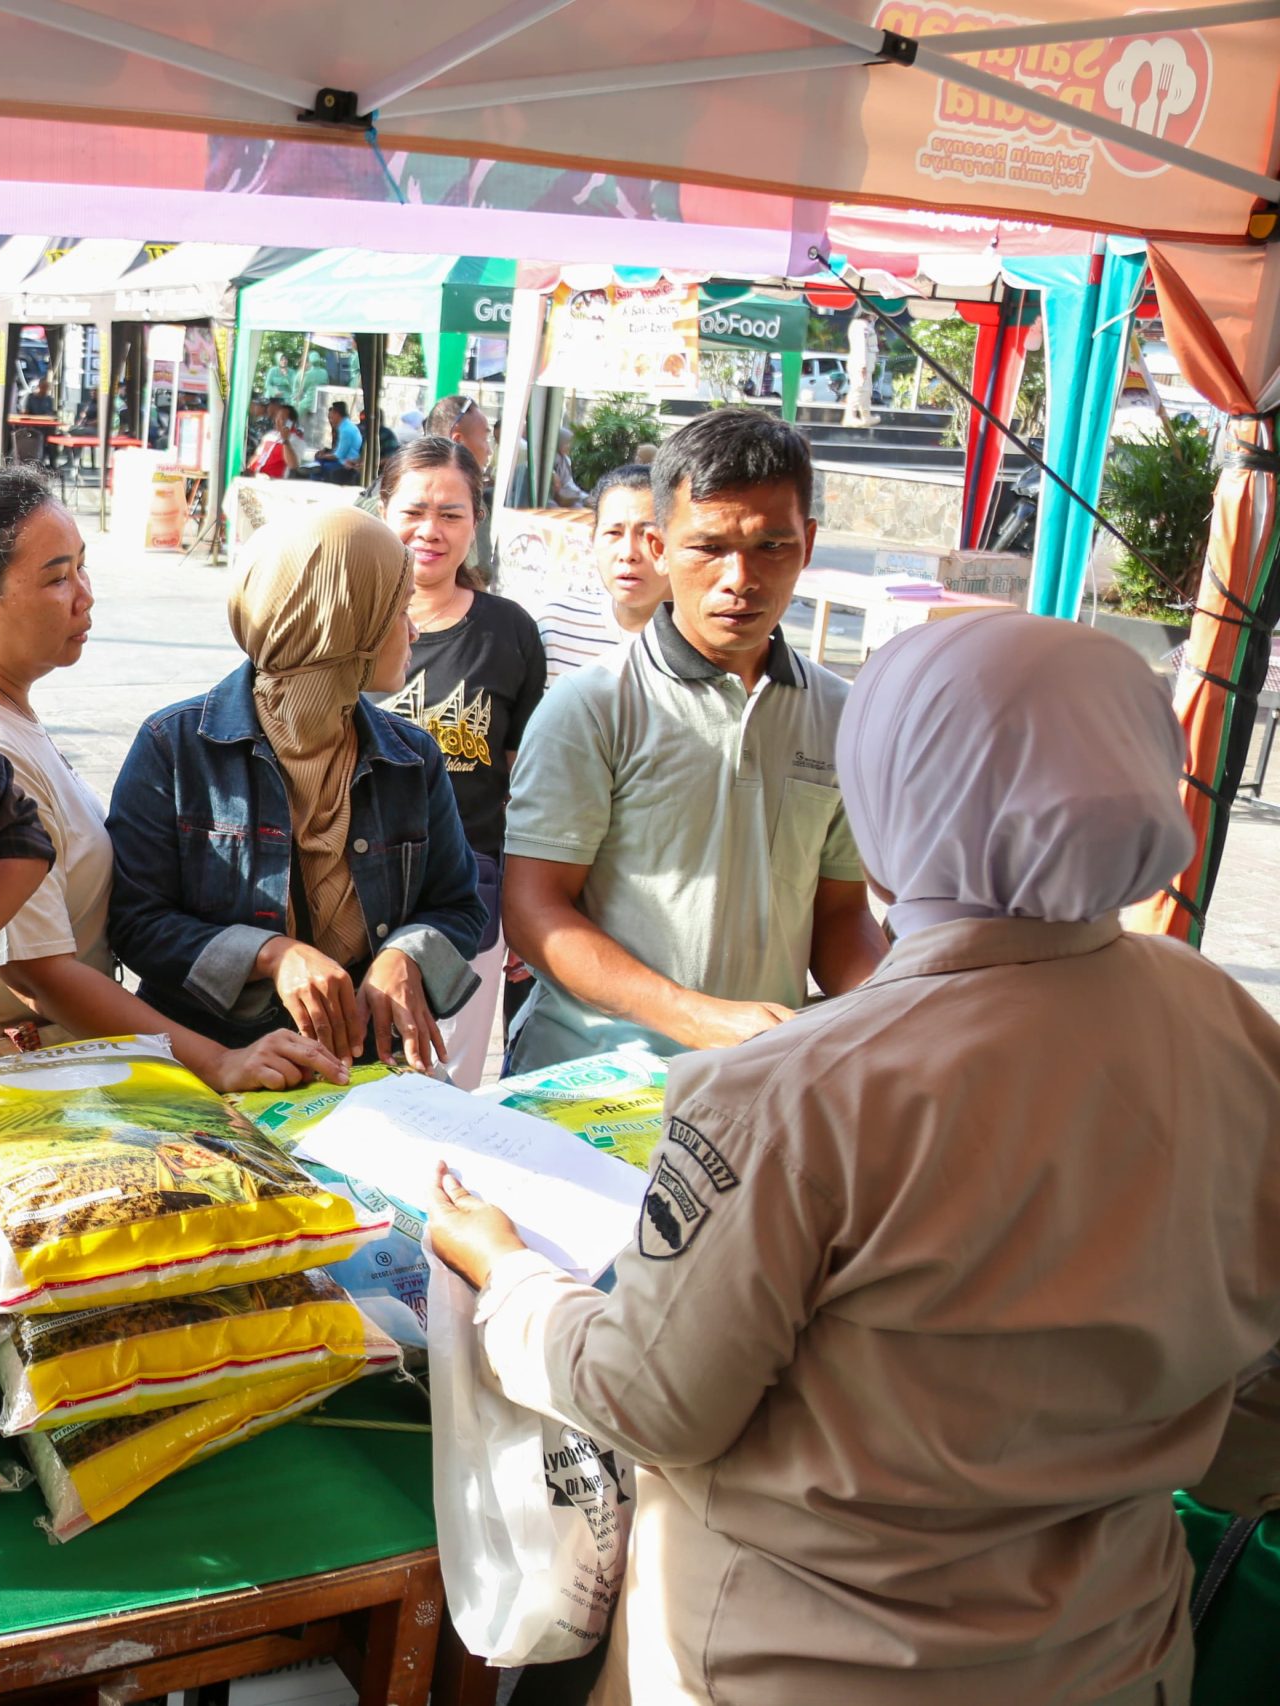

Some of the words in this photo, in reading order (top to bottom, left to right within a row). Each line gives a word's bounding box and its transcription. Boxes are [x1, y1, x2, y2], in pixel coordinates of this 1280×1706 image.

[592, 1120, 645, 1135] MUTU
[671, 1122, 703, 1151] KODIM
[565, 1477, 579, 1496] Di
